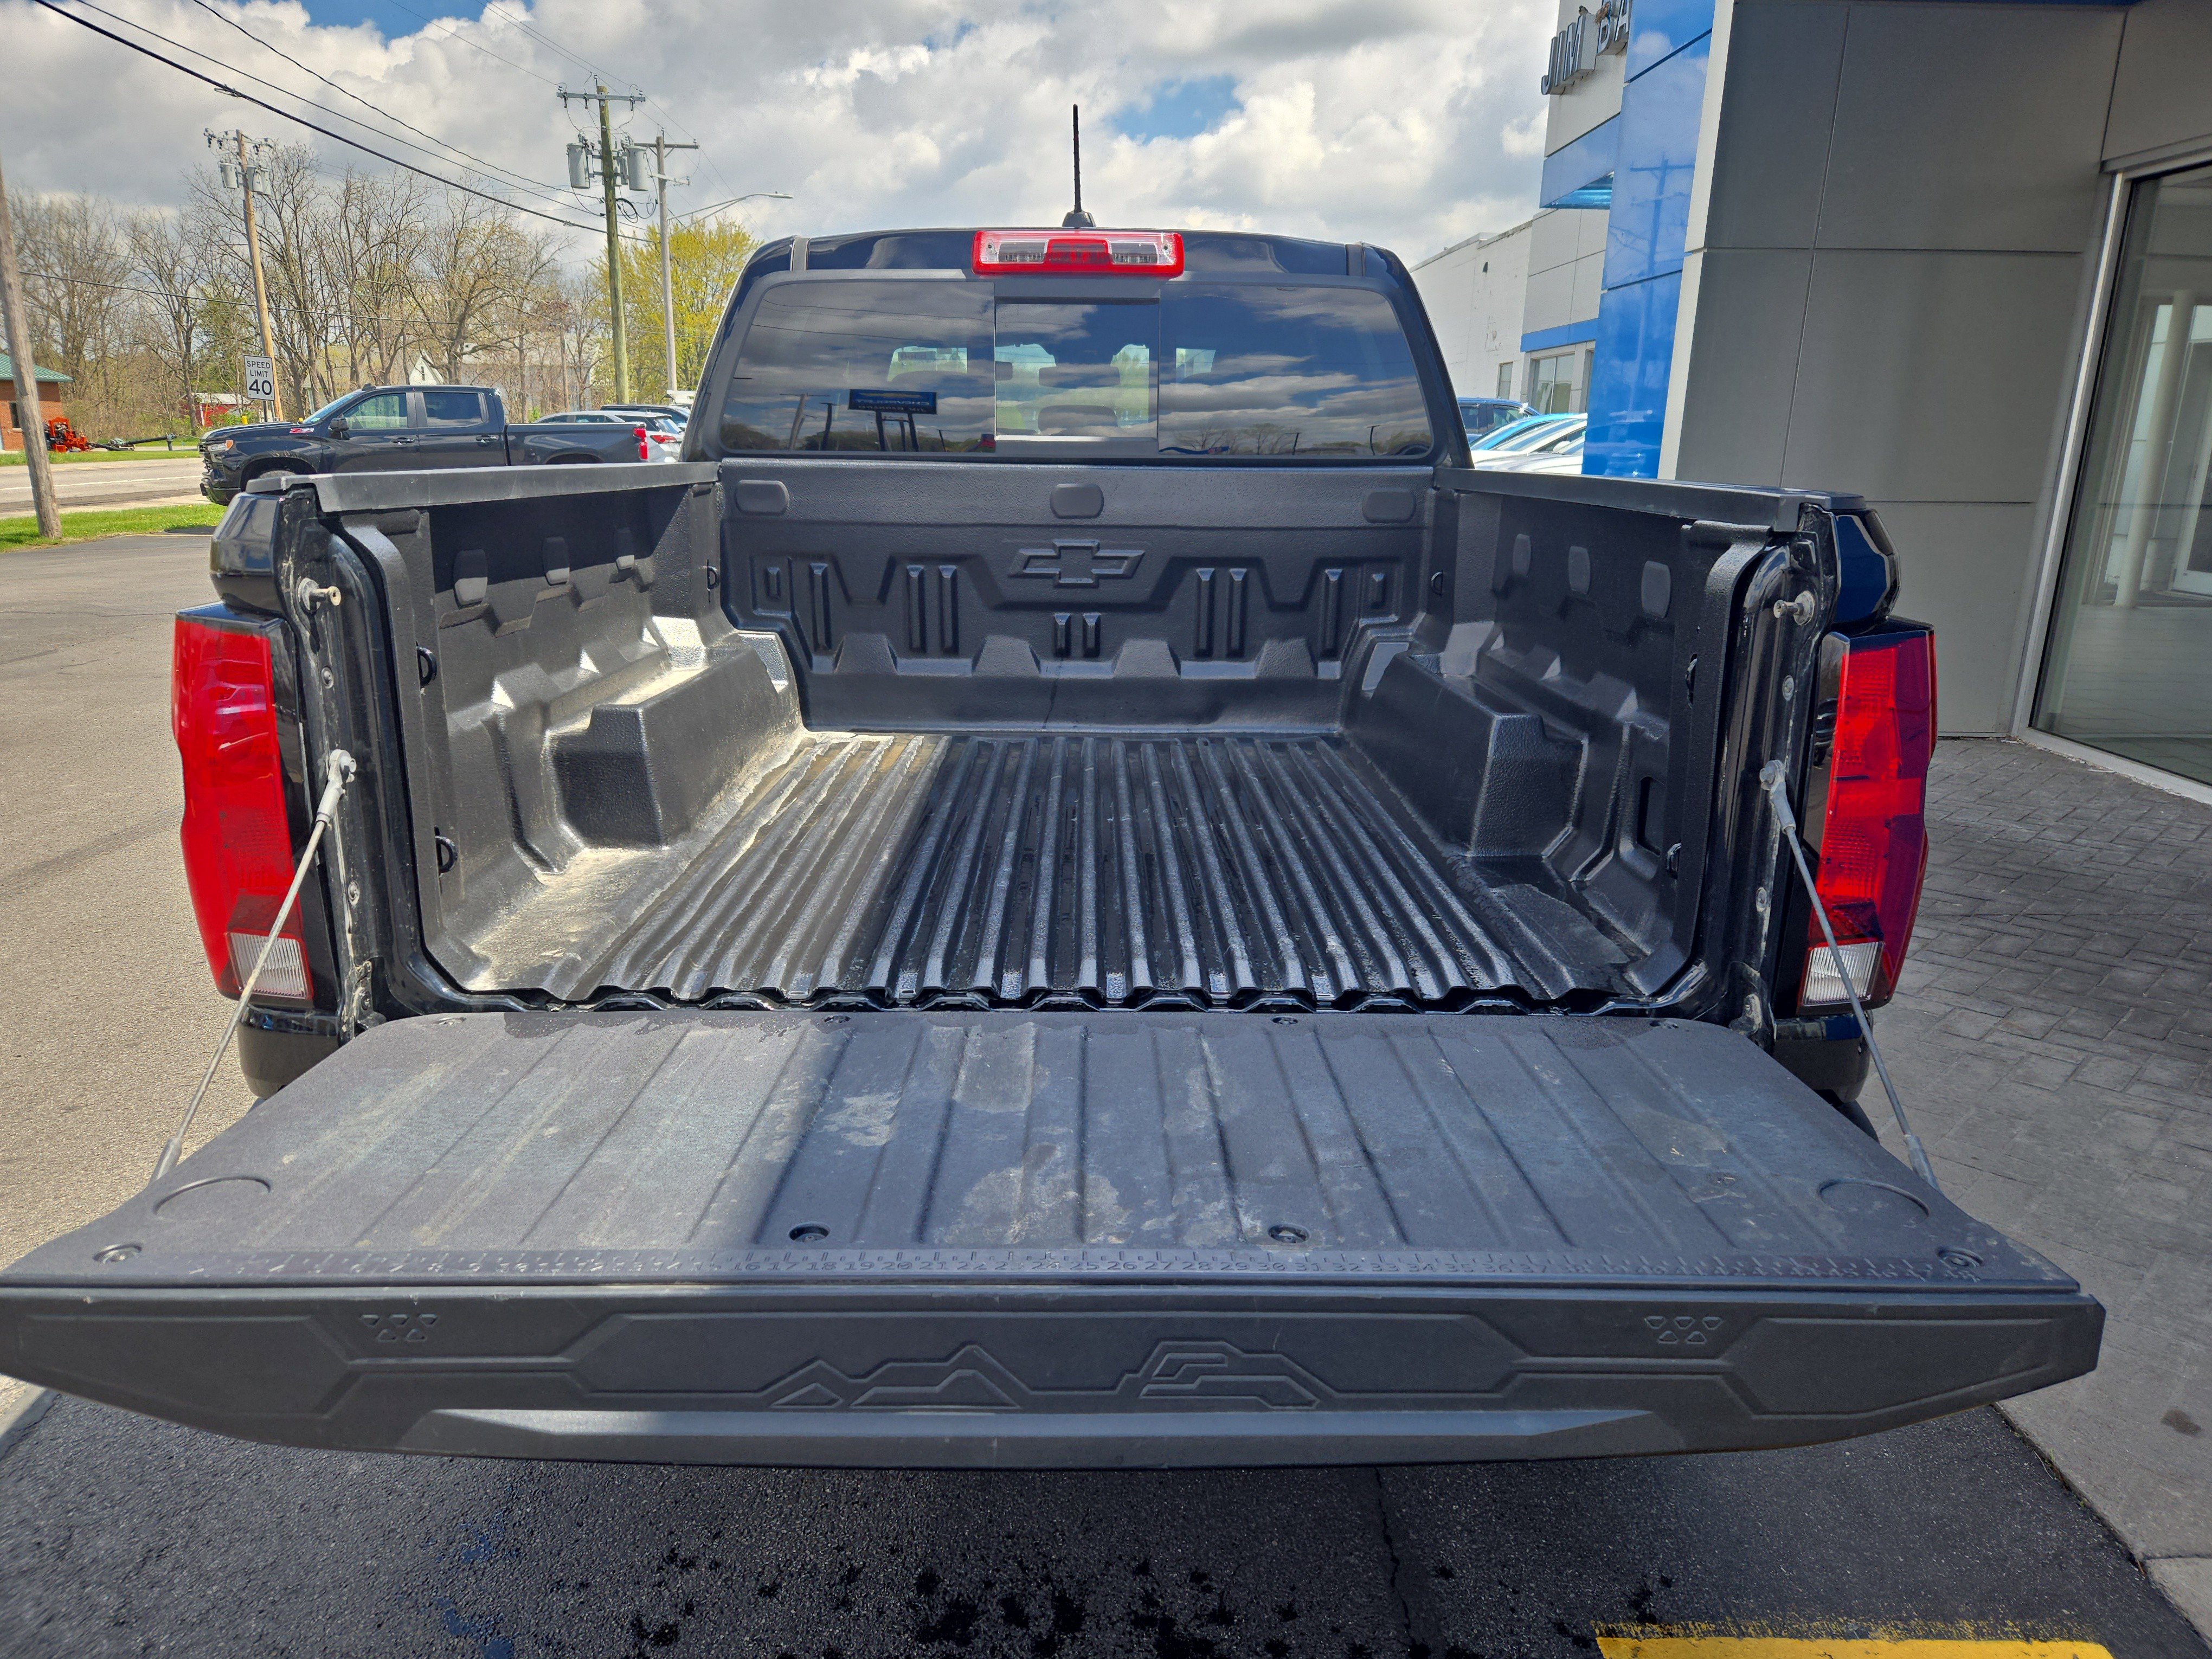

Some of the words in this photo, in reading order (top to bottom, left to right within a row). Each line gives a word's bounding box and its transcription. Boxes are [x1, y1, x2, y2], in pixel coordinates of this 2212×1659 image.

[1541, 15, 1586, 95] JIM
[247, 361, 271, 369] SPEED
[249, 379, 272, 395] 40
[807, 1262, 838, 1271] 18
[844, 1262, 875, 1271] 19
[1107, 1261, 1137, 1270] 26
